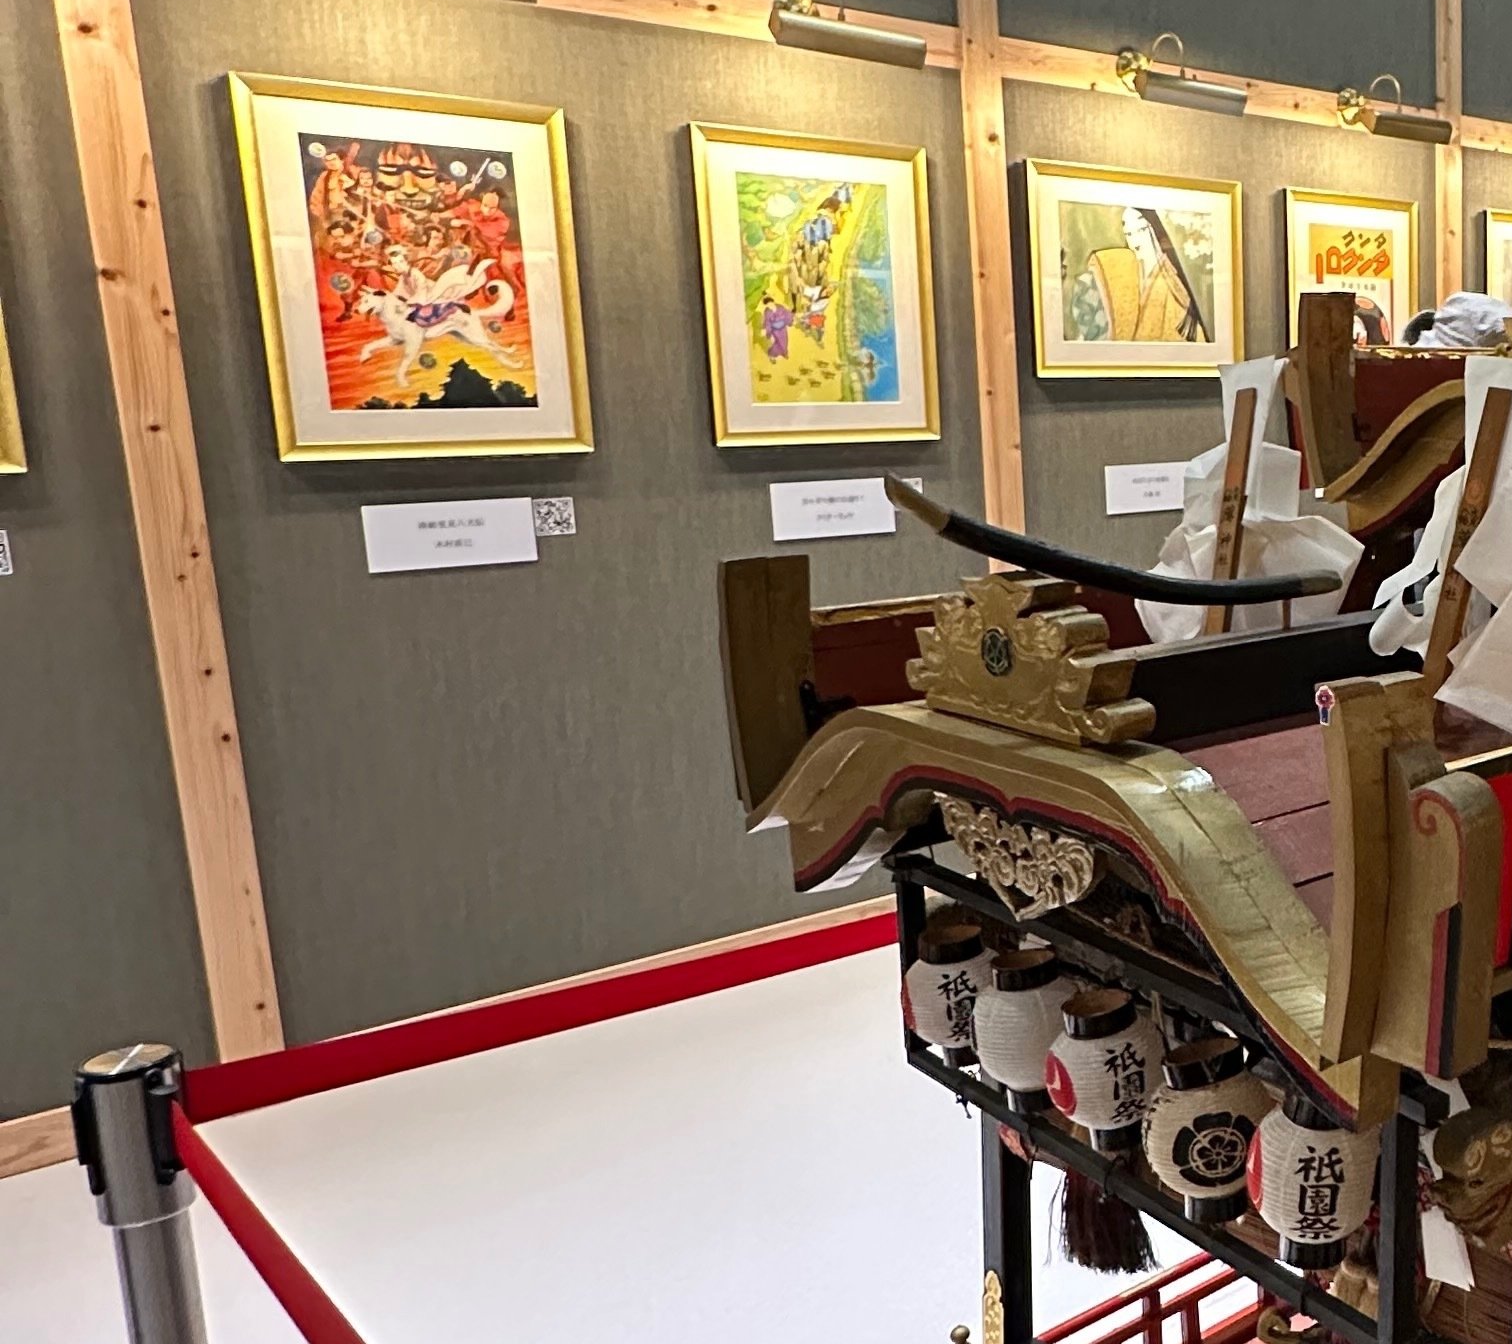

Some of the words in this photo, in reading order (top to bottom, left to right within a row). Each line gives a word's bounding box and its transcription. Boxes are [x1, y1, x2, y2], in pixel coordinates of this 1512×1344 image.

[1104, 1042, 1147, 1124] 祇園祭
[1292, 1145, 1345, 1239] 祇園祭
